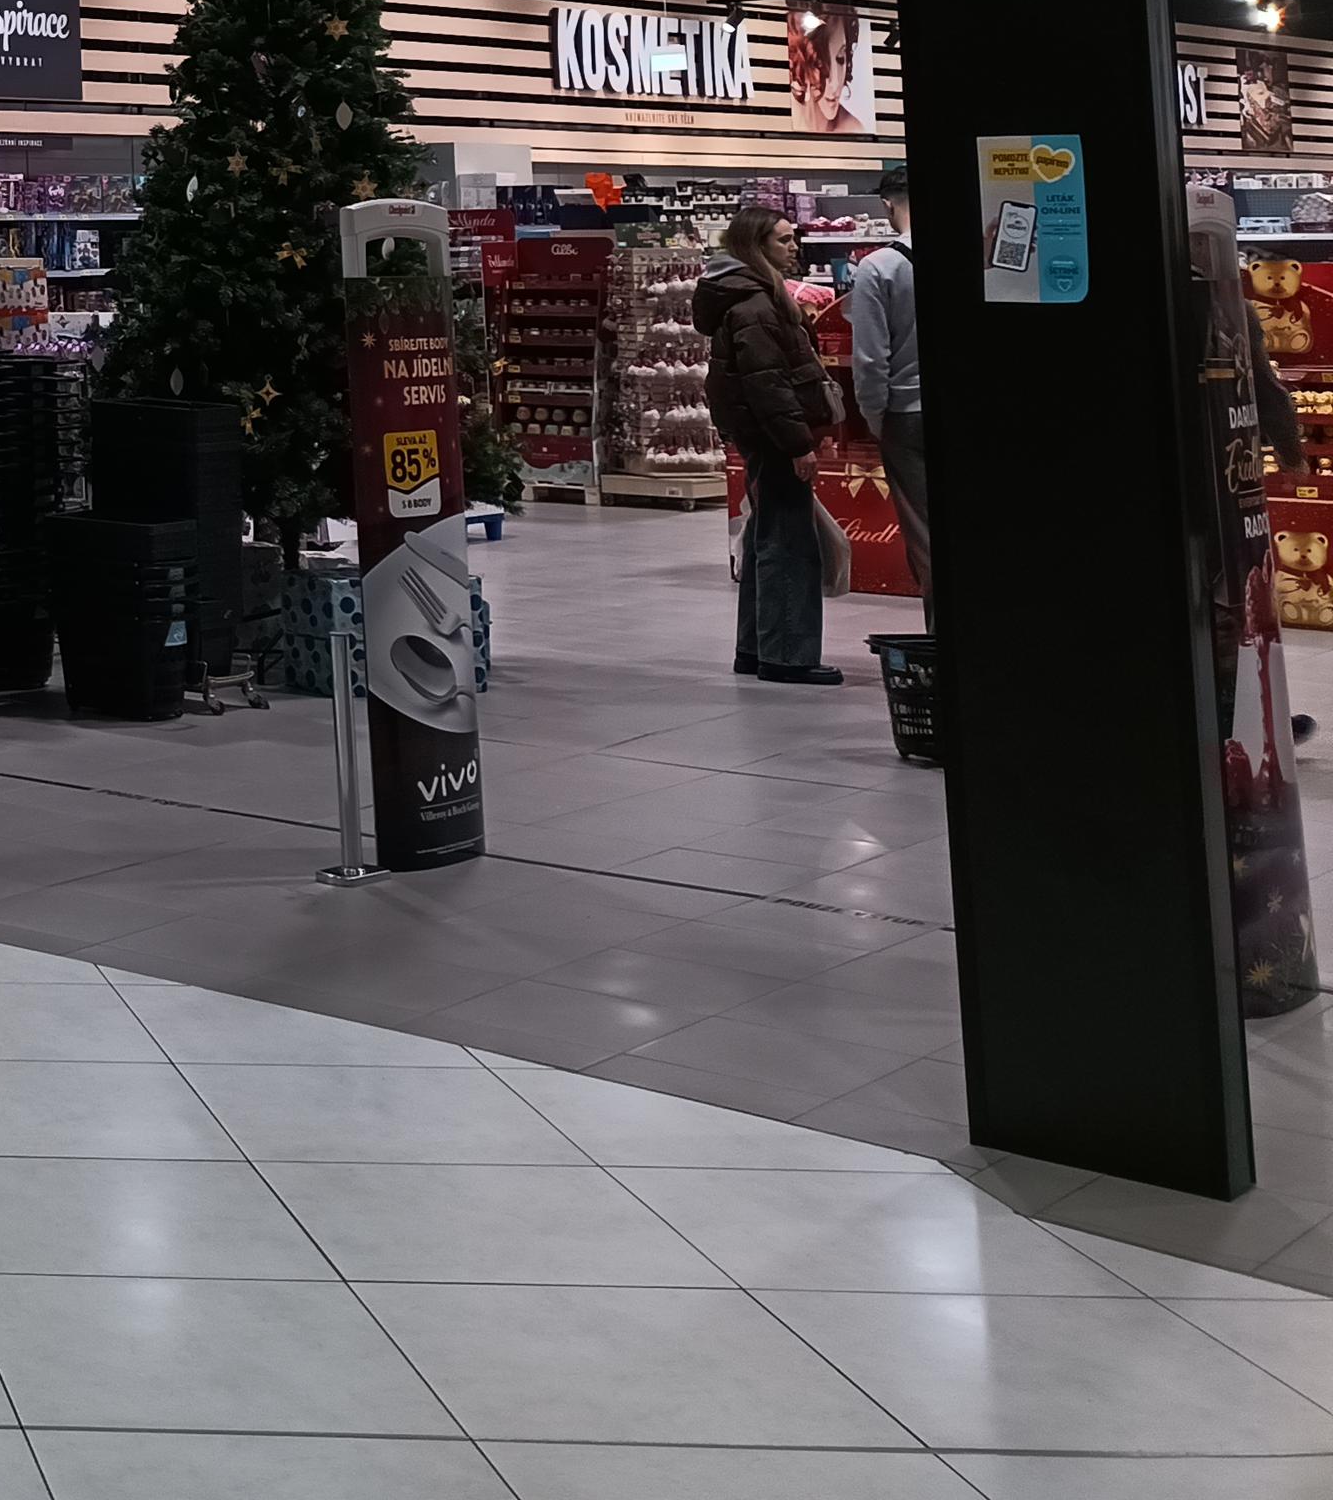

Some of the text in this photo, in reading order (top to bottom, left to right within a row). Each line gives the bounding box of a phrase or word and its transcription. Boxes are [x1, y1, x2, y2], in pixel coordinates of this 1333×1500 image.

[550, 8, 754, 99] KOSMETIKA
[384, 353, 454, 379] NA JÍDELNÍ
[403, 384, 446, 406] SERVIS
[836, 517, 901, 543] Lindt
[417, 759, 477, 802] vivo
